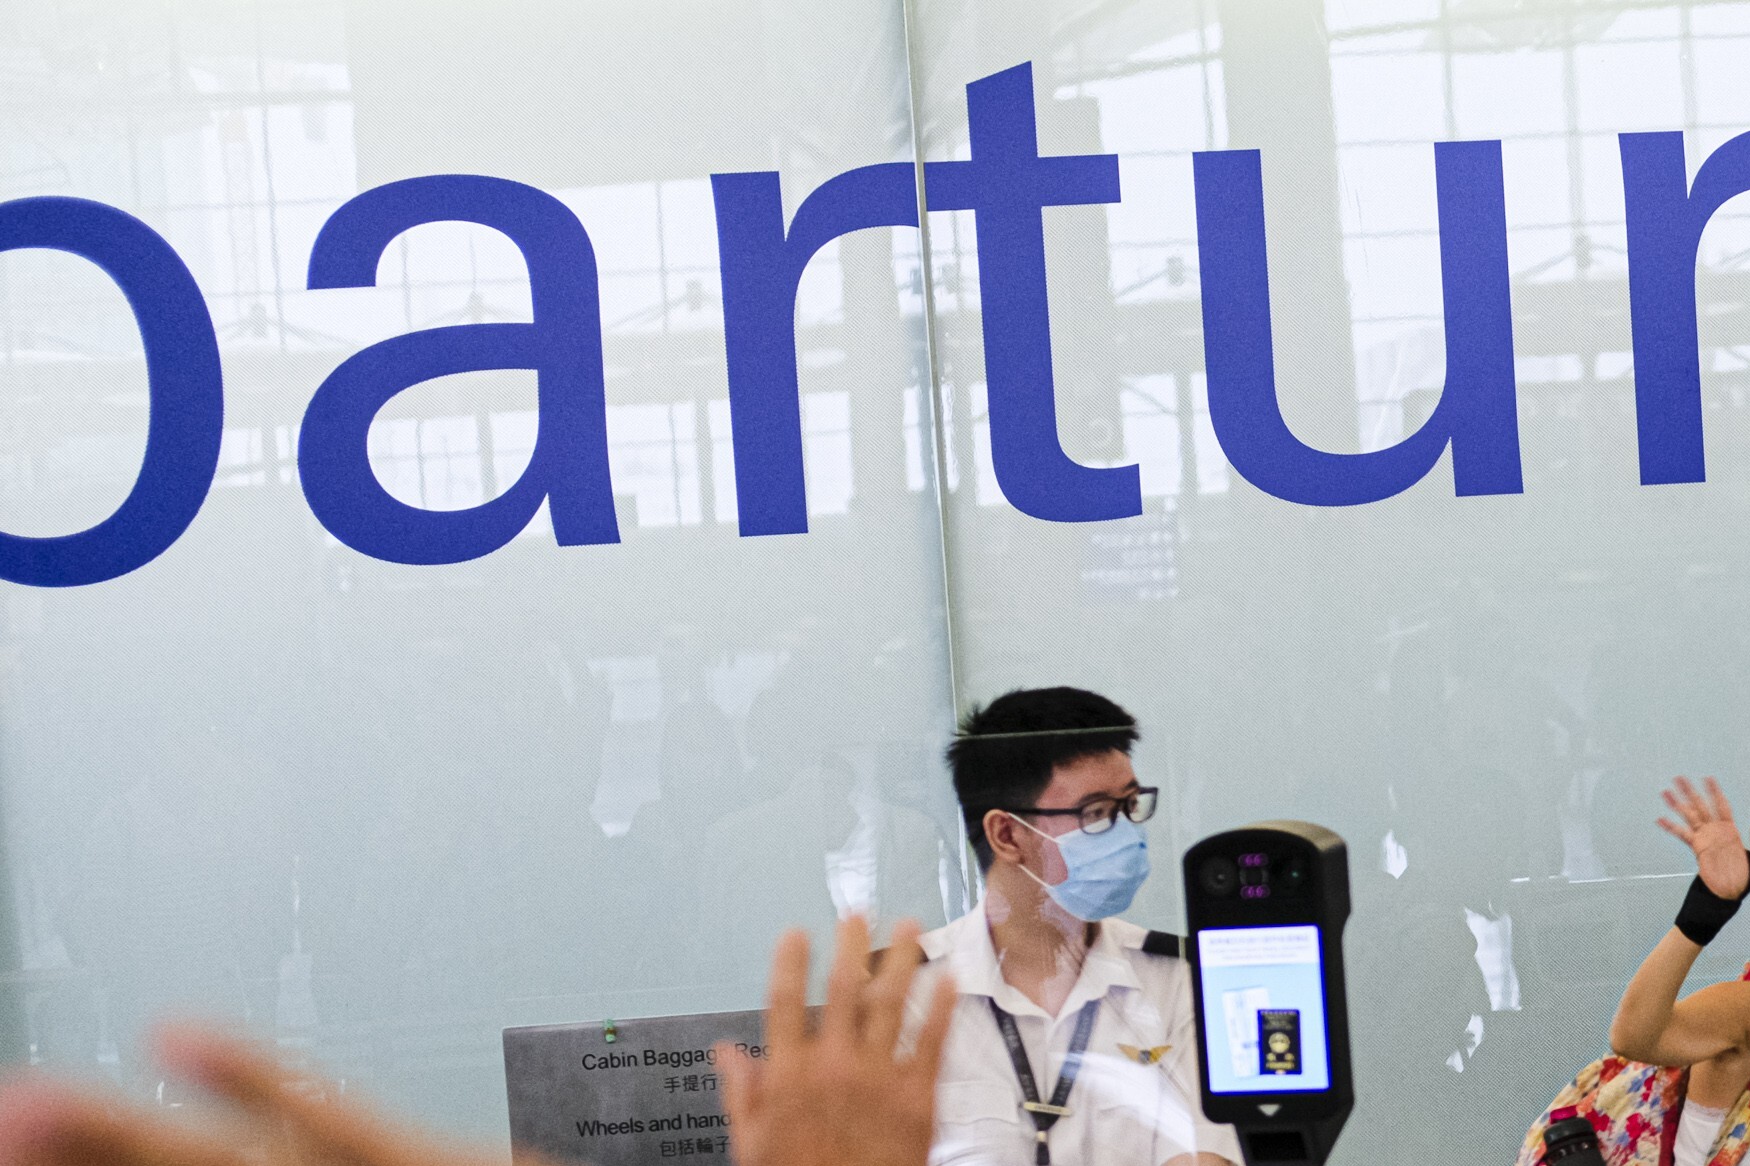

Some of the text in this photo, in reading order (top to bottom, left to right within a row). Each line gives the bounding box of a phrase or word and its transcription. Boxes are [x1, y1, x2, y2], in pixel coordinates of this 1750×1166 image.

[582, 1051, 638, 1071] Cabin
[664, 1073, 727, 1094] 手提行
[576, 1117, 645, 1137] Wheels
[648, 1113, 682, 1132] and
